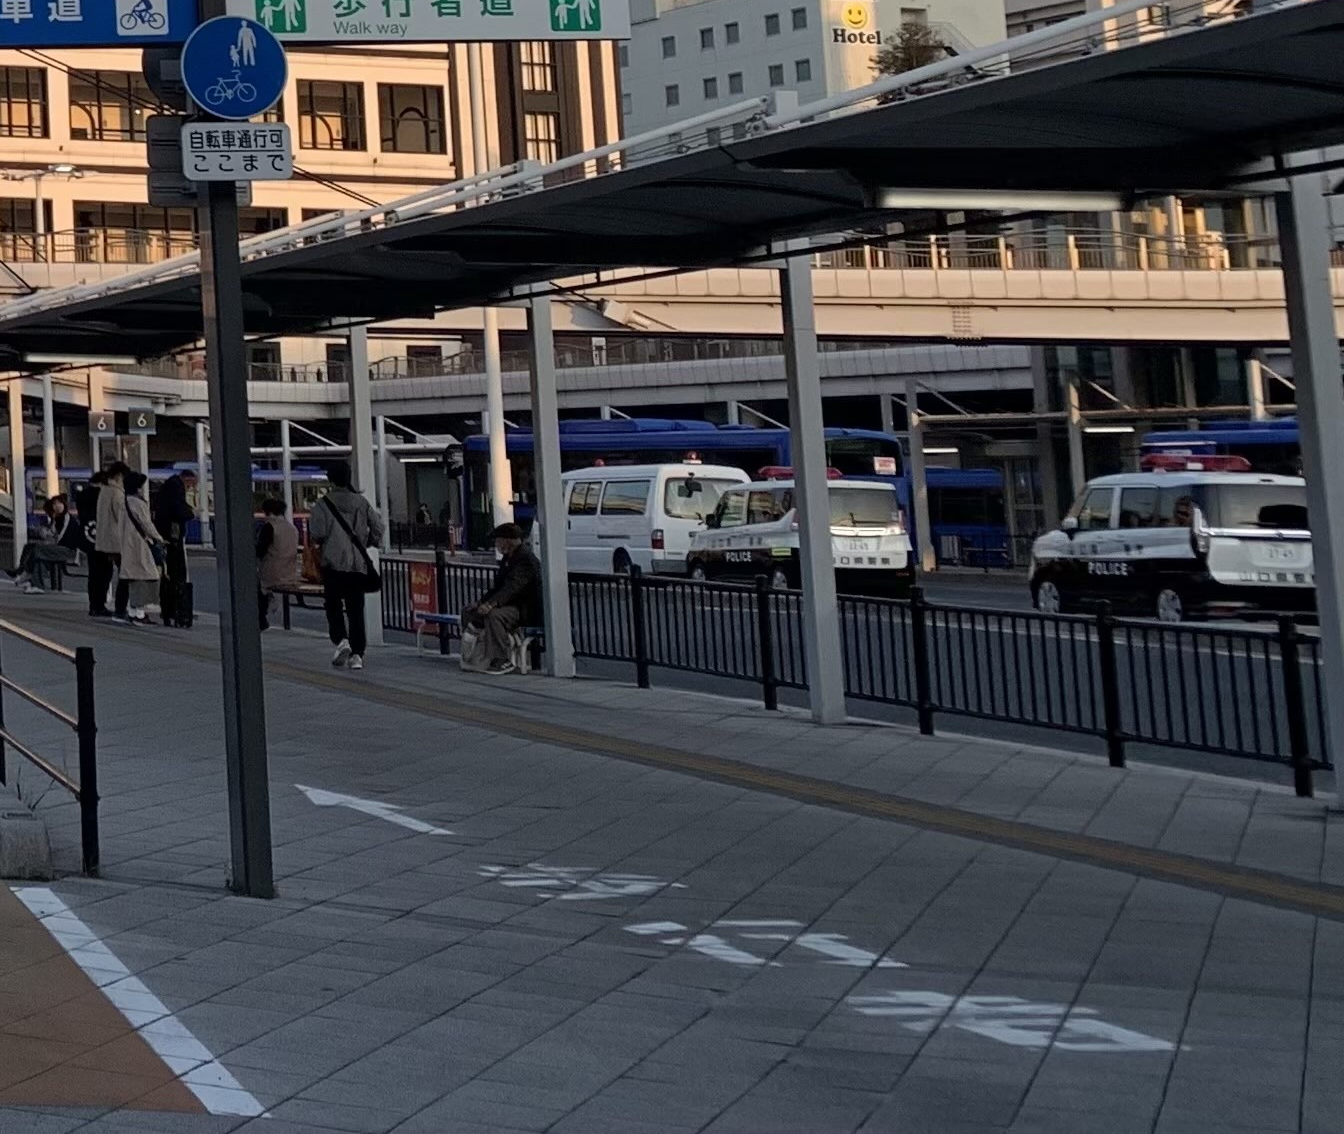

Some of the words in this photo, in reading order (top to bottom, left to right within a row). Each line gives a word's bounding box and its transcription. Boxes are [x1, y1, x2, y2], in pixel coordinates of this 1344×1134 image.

[333, 21, 373, 36] Walk
[376, 24, 409, 38] way
[832, 28, 882, 45] Hotel
[190, 129, 284, 150] 自転車通行可
[194, 154, 285, 172] ここまで
[97, 417, 106, 430] 6
[137, 413, 146, 427] 6
[725, 551, 752, 563] POLICE
[1088, 561, 1128, 576] POLICE
